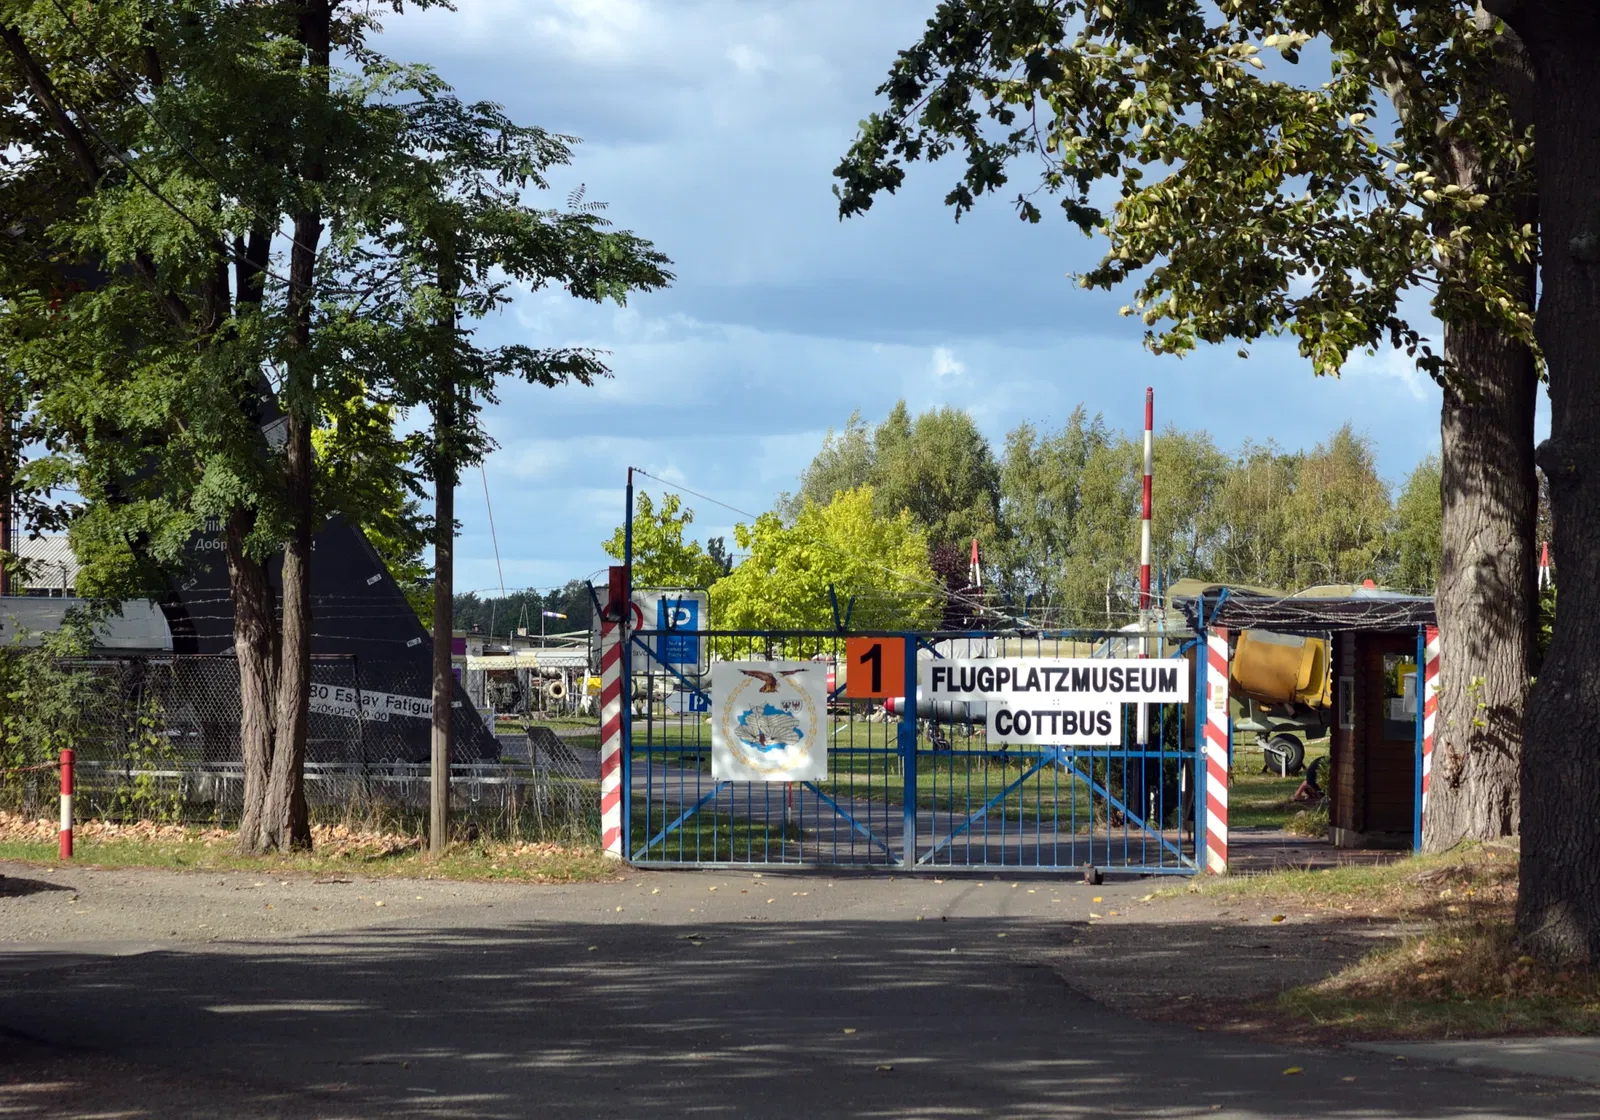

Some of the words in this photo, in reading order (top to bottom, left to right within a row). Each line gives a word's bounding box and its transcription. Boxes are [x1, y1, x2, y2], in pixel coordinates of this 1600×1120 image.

[194, 538, 227, 551] Добр
[667, 607, 691, 629] P
[860, 643, 882, 693] 1
[931, 666, 1177, 693] FLUGPLATZMUSEUM
[309, 685, 329, 699] 80
[386, 695, 433, 715] Fatigu
[694, 696, 705, 710] P
[994, 709, 1112, 736] COTTBUS
